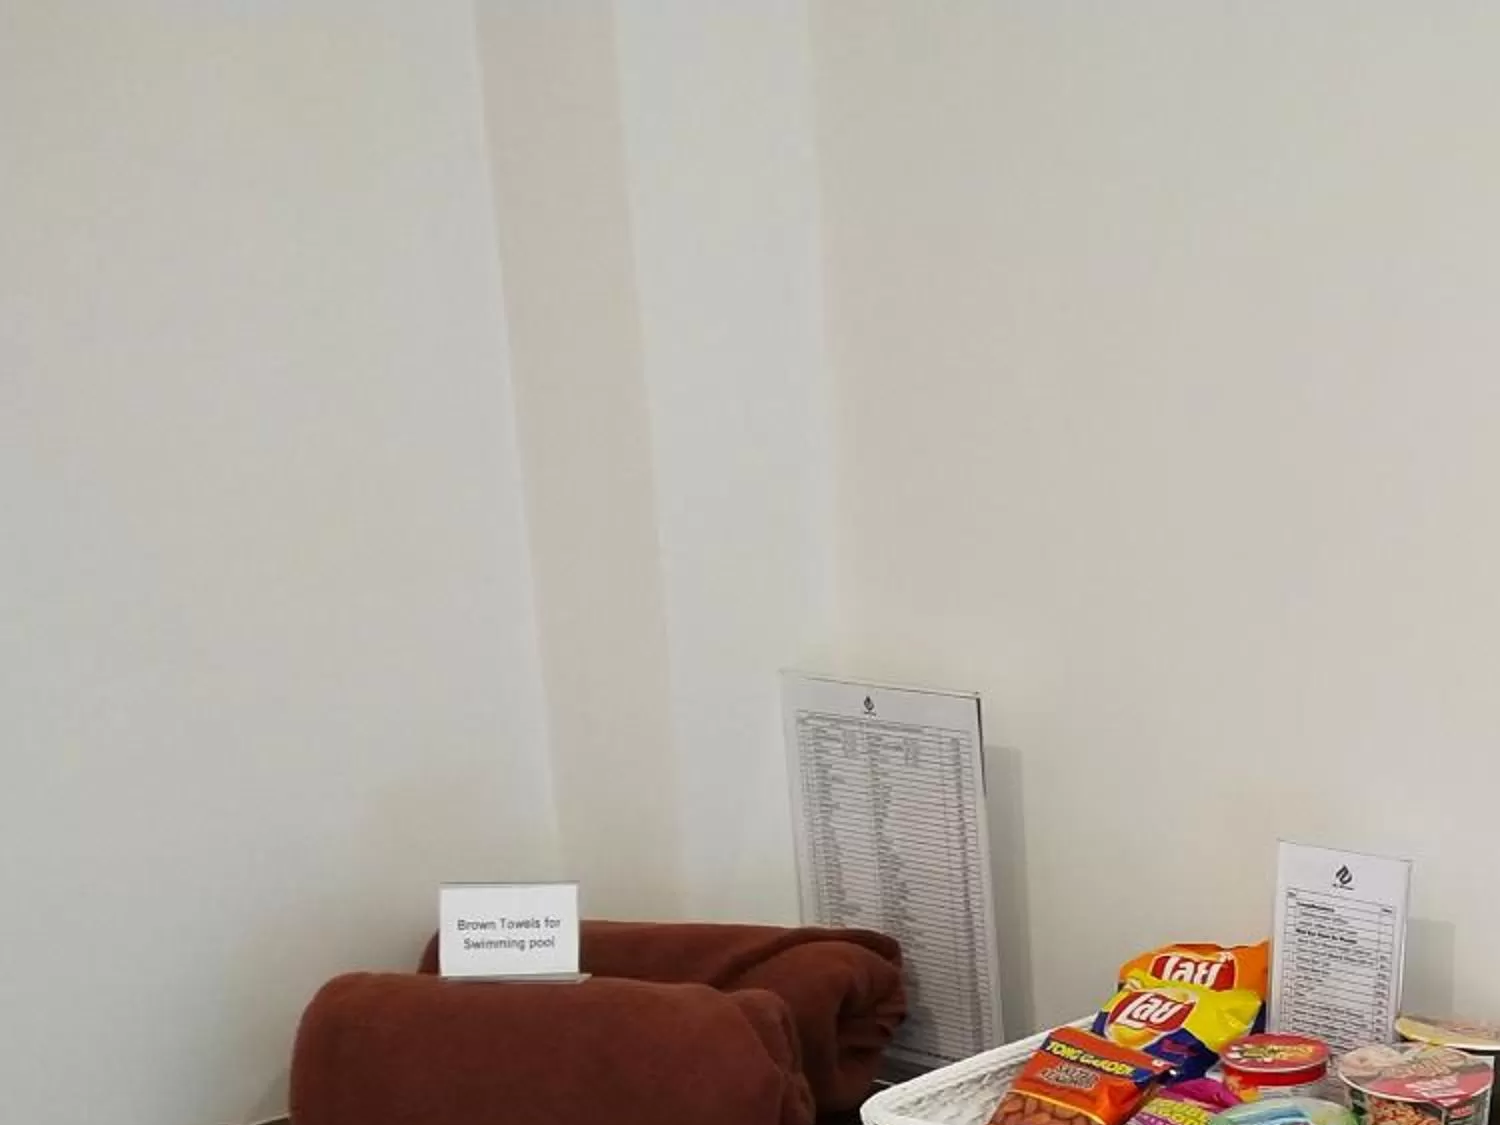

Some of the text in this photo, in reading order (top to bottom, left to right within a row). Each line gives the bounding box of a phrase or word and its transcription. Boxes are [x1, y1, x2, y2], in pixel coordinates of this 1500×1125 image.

[457, 915, 561, 931] Brown Towels for
[463, 936, 556, 951] Swimming pool
